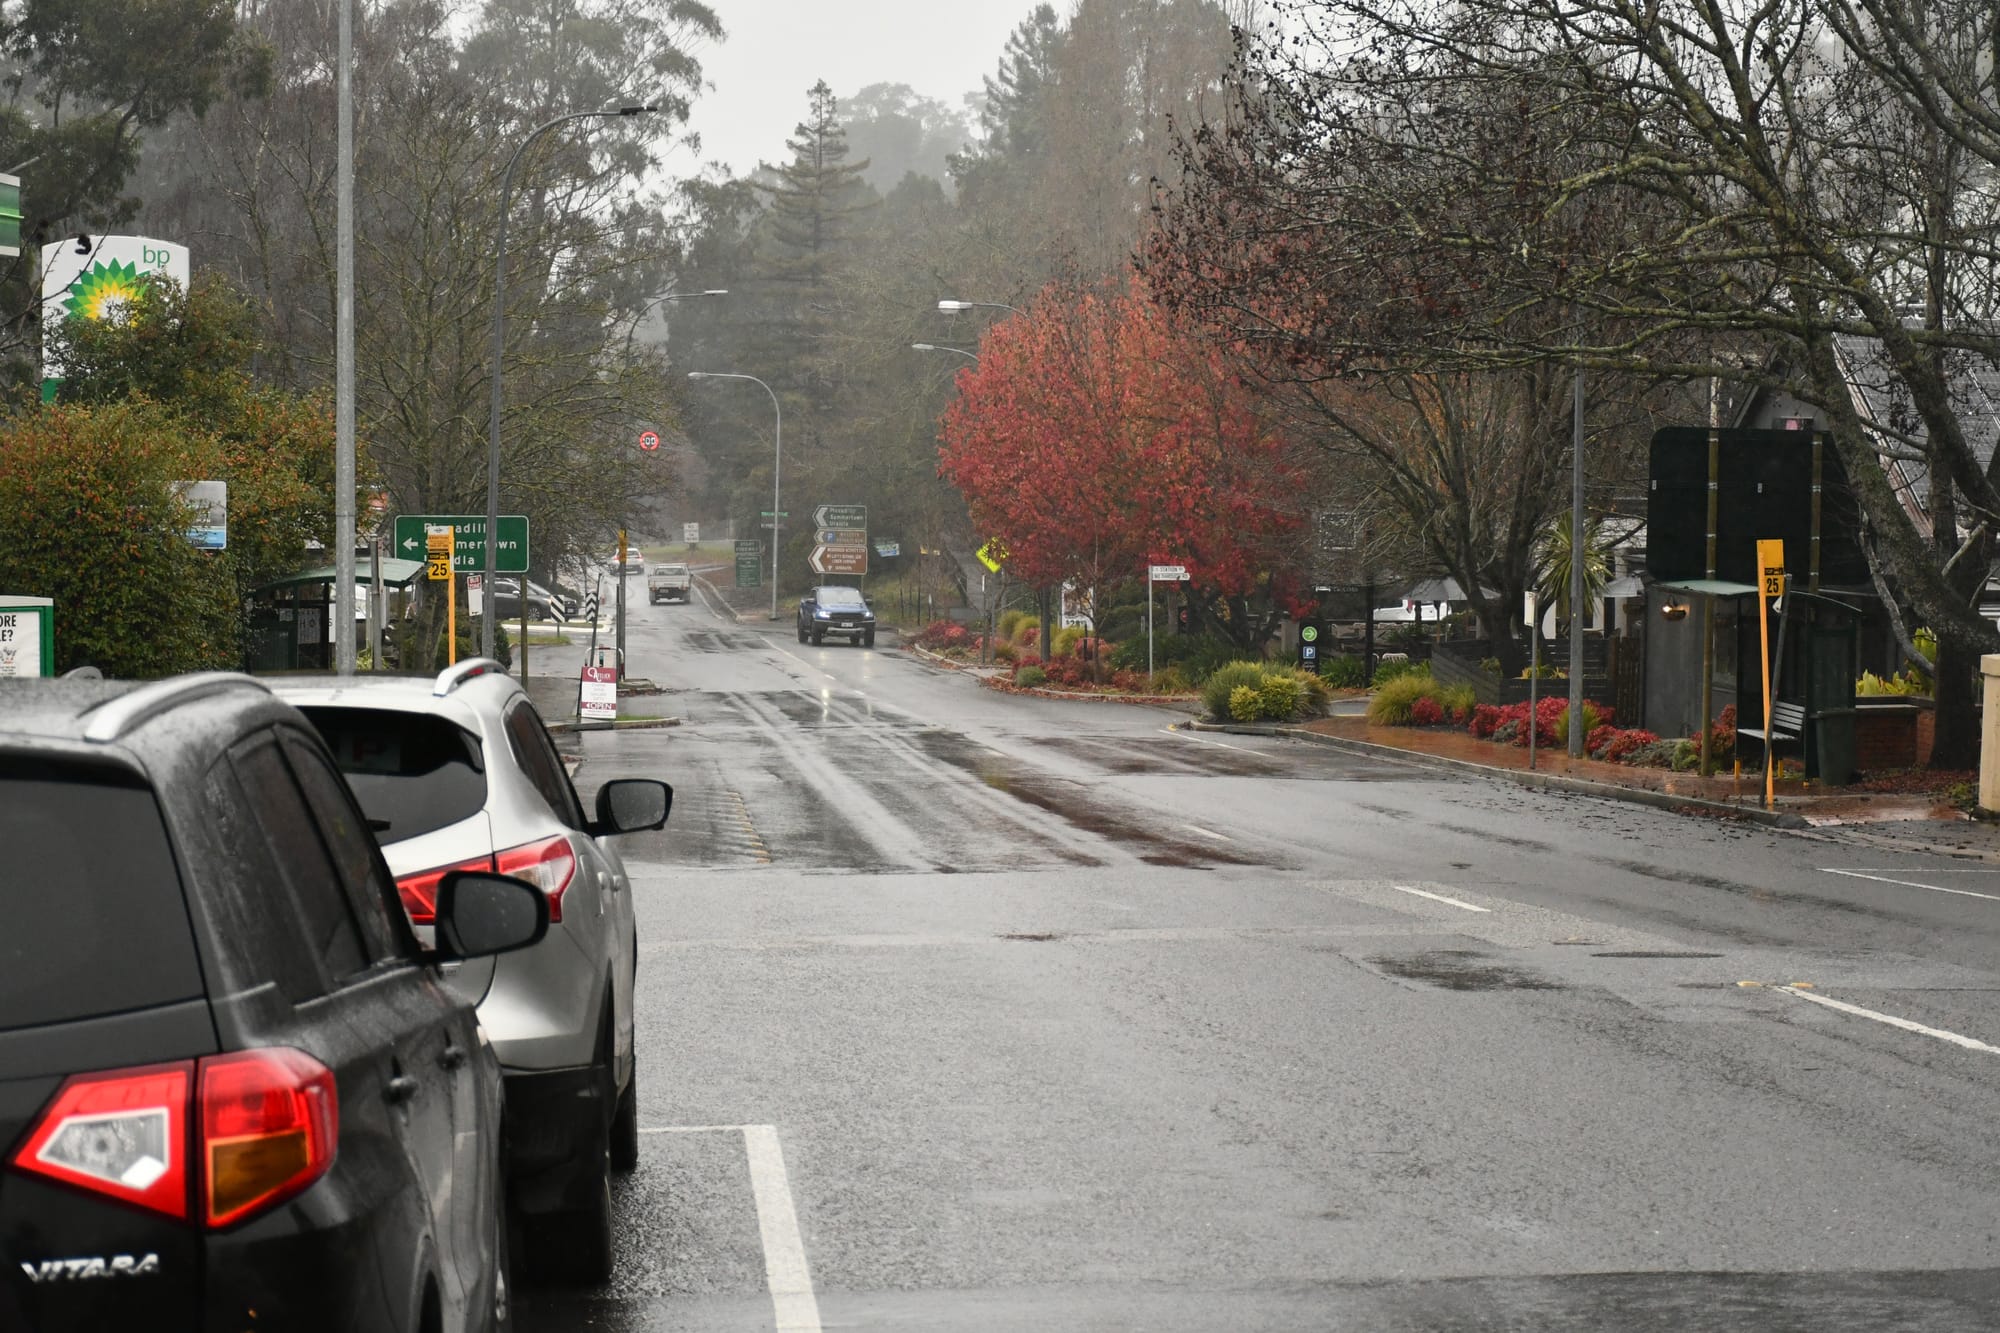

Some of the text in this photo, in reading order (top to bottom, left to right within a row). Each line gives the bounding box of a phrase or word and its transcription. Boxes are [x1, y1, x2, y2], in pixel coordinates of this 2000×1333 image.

[143, 245, 170, 268] bp
[431, 563, 448, 577] 25
[1766, 578, 1779, 593] 25
[1306, 648, 1314, 657] P
[591, 702, 612, 710] OPEN
[20, 1253, 159, 1283] VITARA
